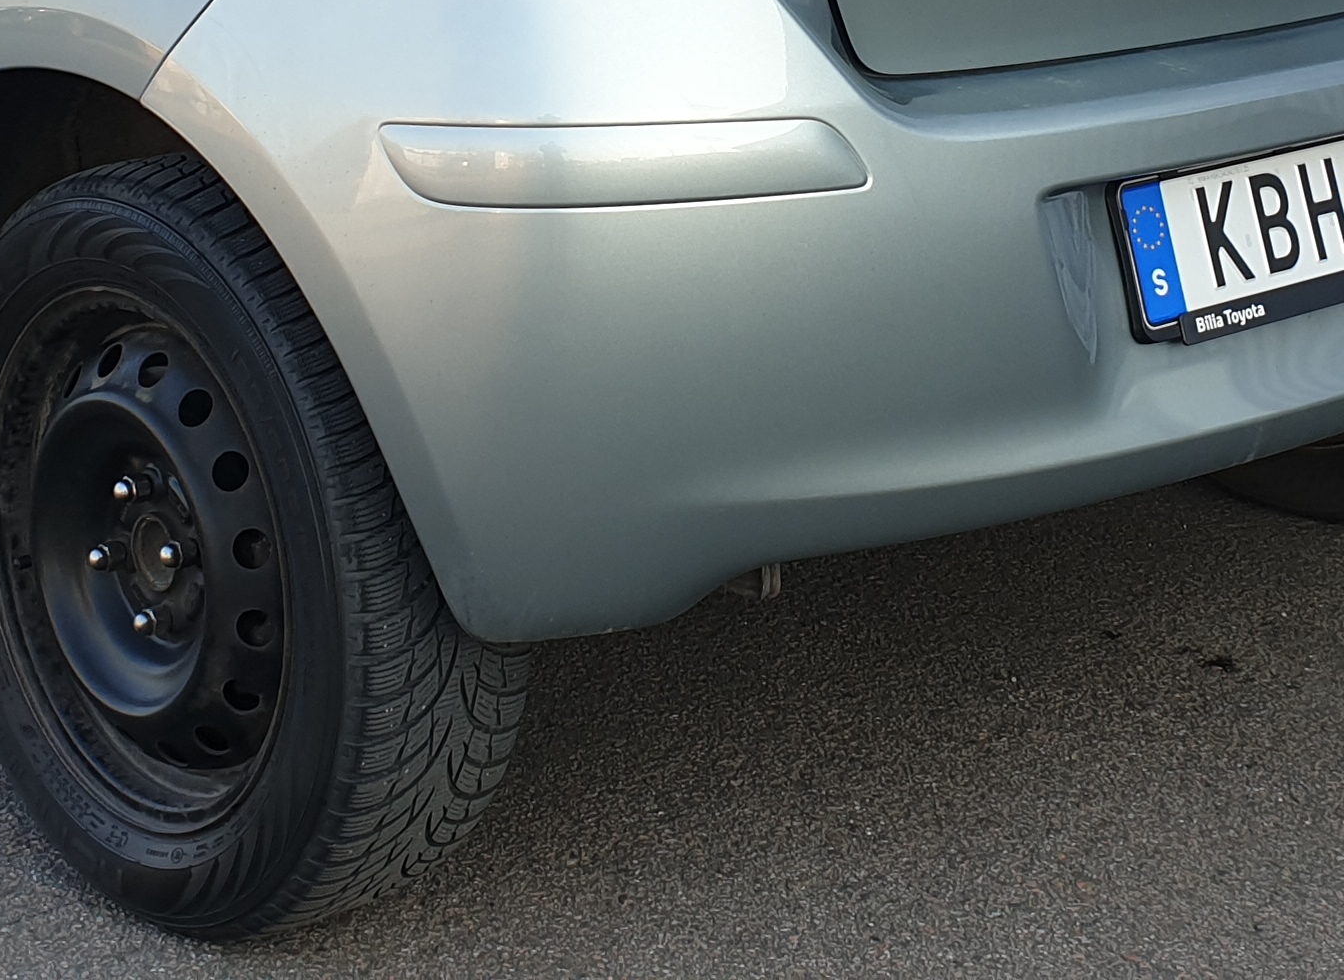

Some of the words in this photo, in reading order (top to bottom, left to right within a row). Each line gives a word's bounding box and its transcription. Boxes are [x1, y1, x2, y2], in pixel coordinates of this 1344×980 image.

[1151, 268, 1170, 297] S
[1195, 312, 1225, 333] Bilia
[1222, 303, 1266, 326] Toyota
